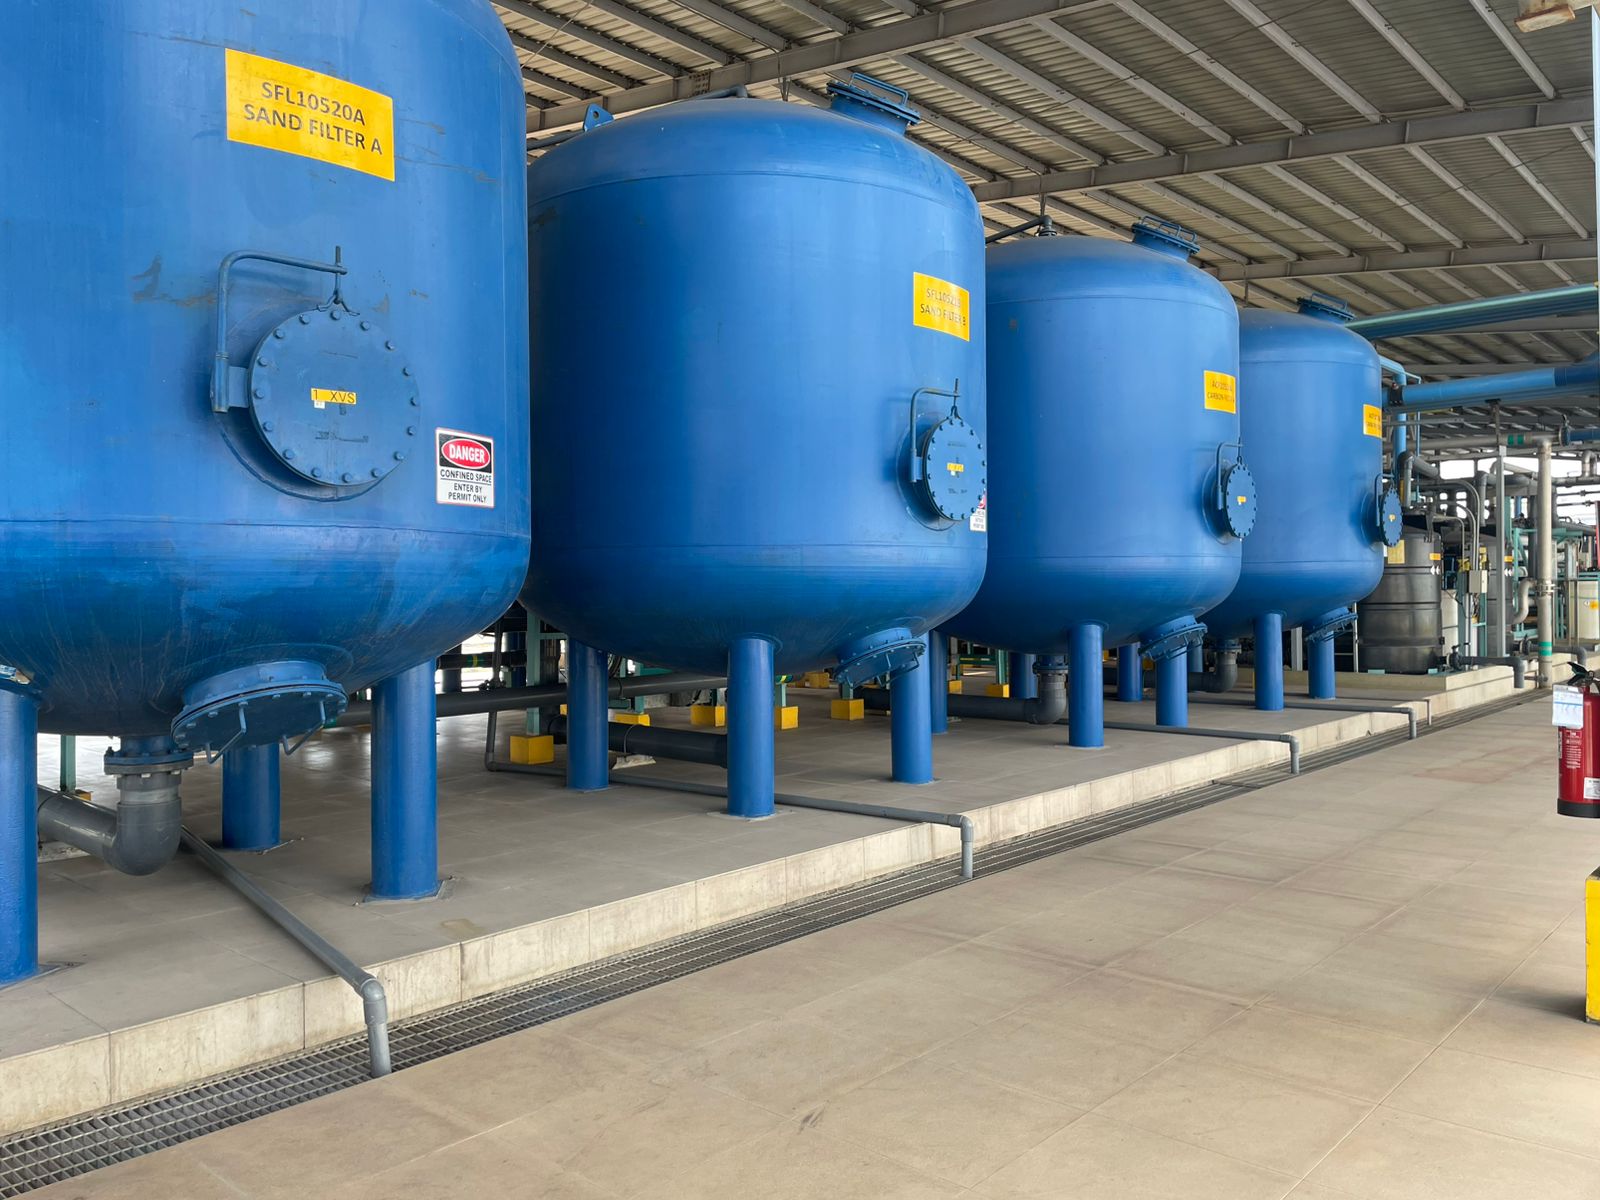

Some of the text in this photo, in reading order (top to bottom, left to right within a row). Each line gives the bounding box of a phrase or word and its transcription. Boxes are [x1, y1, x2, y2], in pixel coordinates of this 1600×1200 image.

[262, 82, 365, 126] SFL10520A
[244, 103, 383, 155] SAND FILTER A
[330, 391, 355, 404] XVS
[449, 444, 485, 463] DANGER
[440, 469, 492, 483] CONFINED SPACE
[454, 483, 483, 493] ENTER BY
[448, 492, 487, 503] PERMIT ONLY
